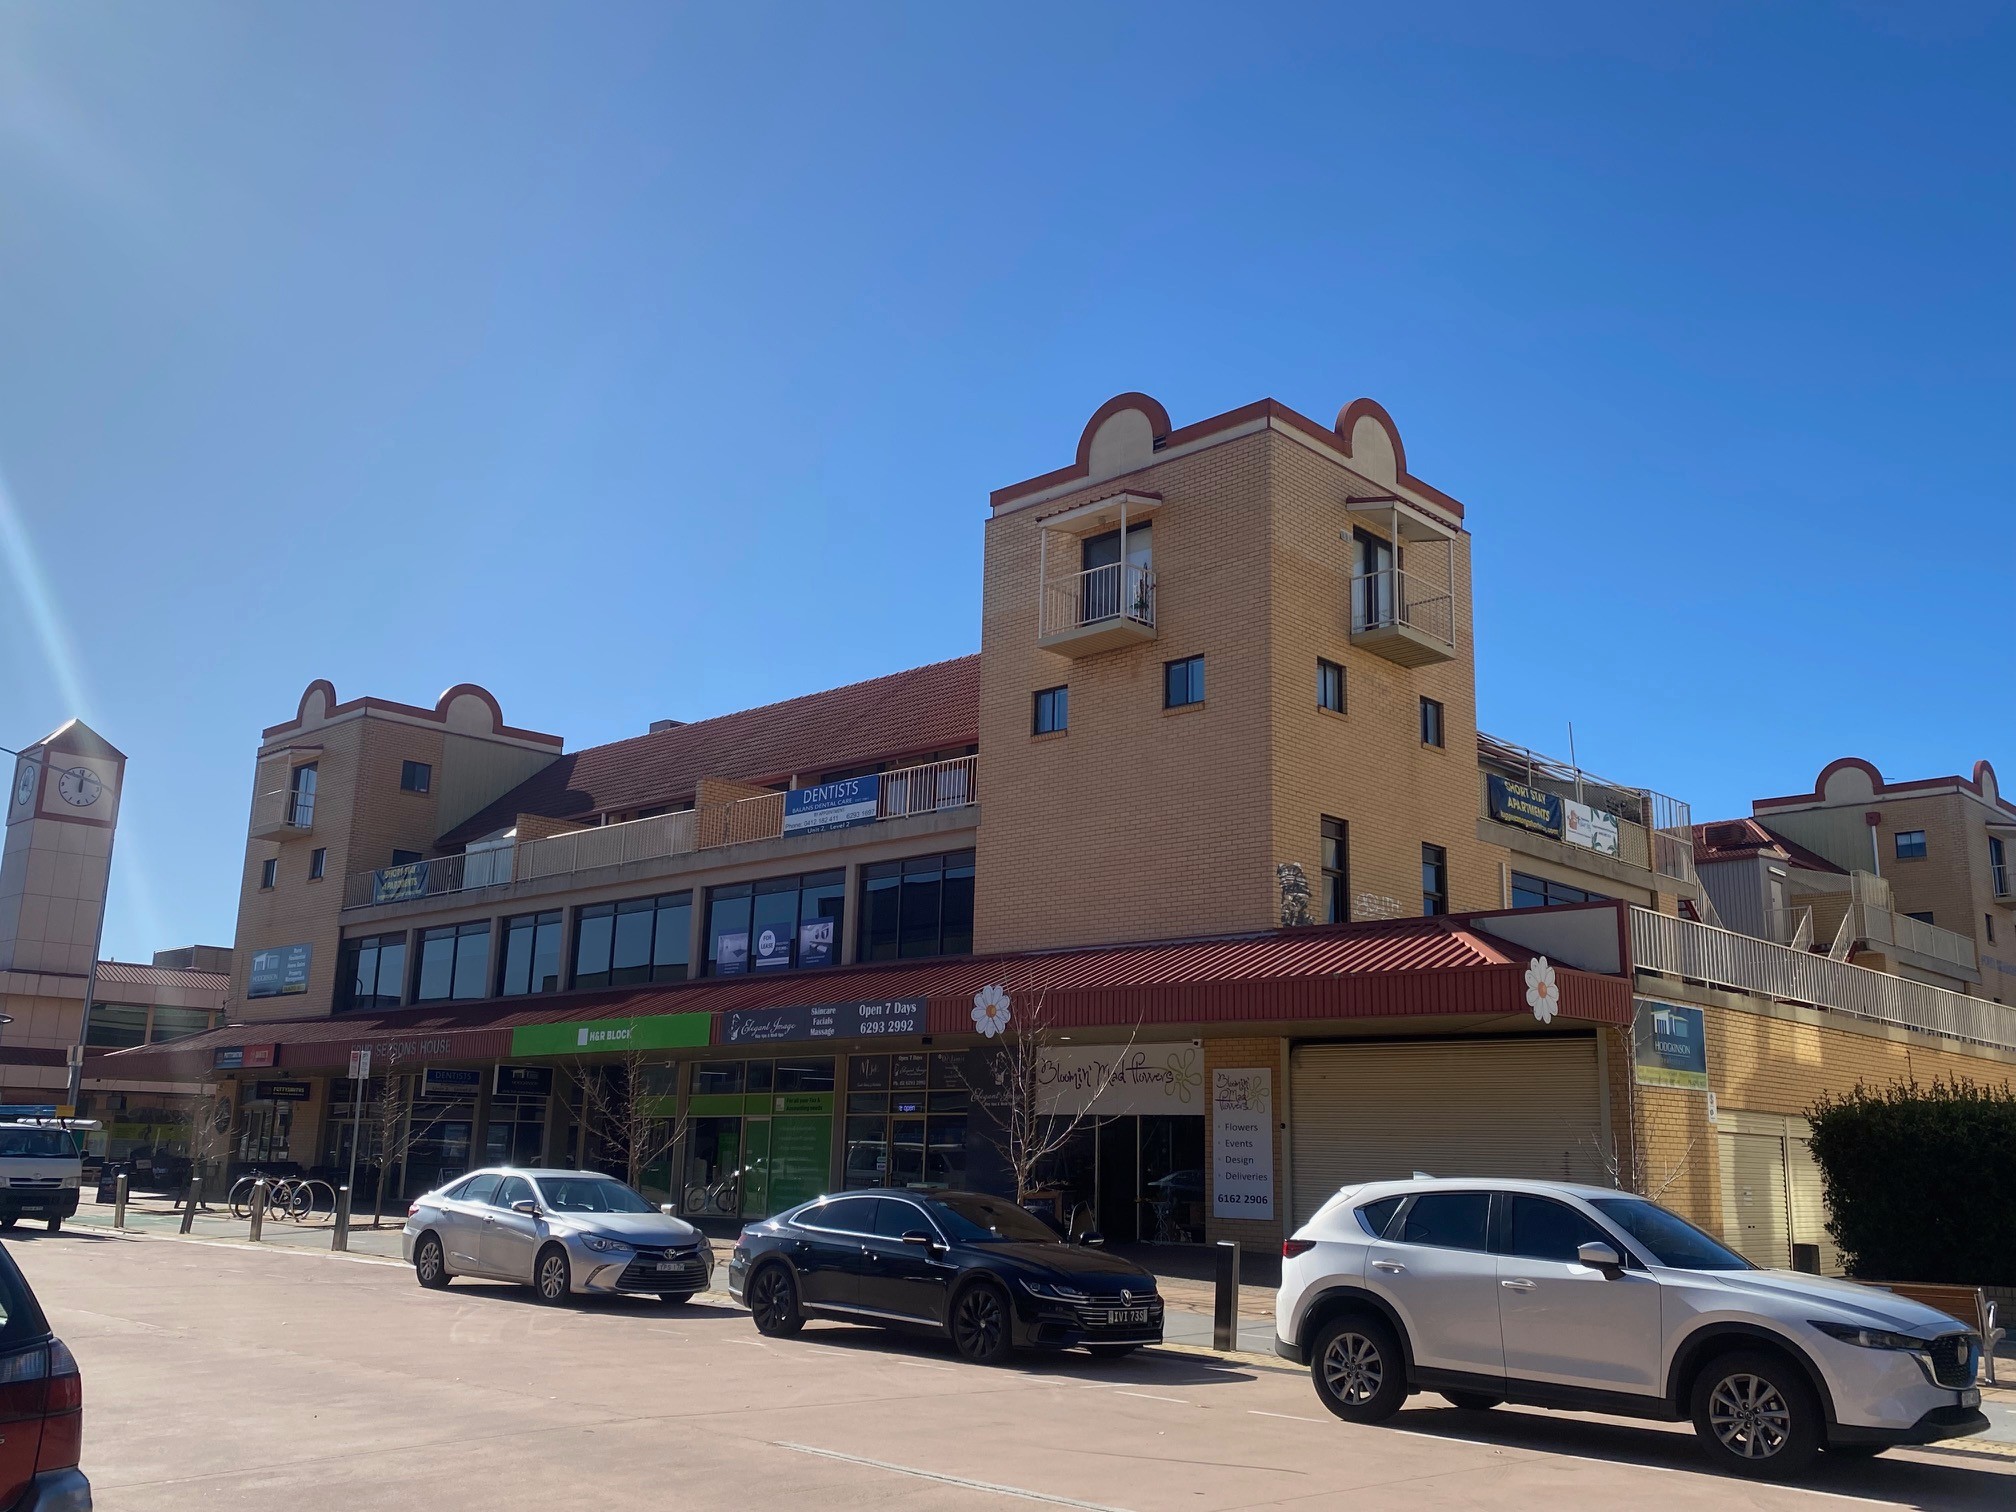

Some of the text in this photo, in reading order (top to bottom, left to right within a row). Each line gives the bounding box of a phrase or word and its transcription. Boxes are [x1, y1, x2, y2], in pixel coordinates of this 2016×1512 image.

[803, 781, 858, 804] DENTISTS
[1504, 781, 1546, 804] SHORT STAY
[1508, 797, 1550, 822] APARTMENTS
[859, 1002, 916, 1018] Open 7 Days
[812, 1017, 833, 1025] Facials
[741, 1019, 770, 1036] Elegant
[810, 1028, 834, 1036] Massage
[860, 1020, 913, 1034] 6293 2992
[590, 1030, 632, 1041] H&R BLOCK
[421, 1040, 450, 1054] HOUSE
[1655, 1042, 1690, 1054] HODGKINSON
[435, 1071, 472, 1080] DENTISTS
[1038, 1057, 1092, 1090] Bloomin'
[1094, 1060, 1126, 1086] Mad
[1225, 1123, 1258, 1131] Flowers
[1225, 1140, 1253, 1148] Events
[1225, 1156, 1254, 1165] Design
[1225, 1172, 1268, 1181] Deliveries
[1218, 1194, 1268, 1204] 6162 2906
